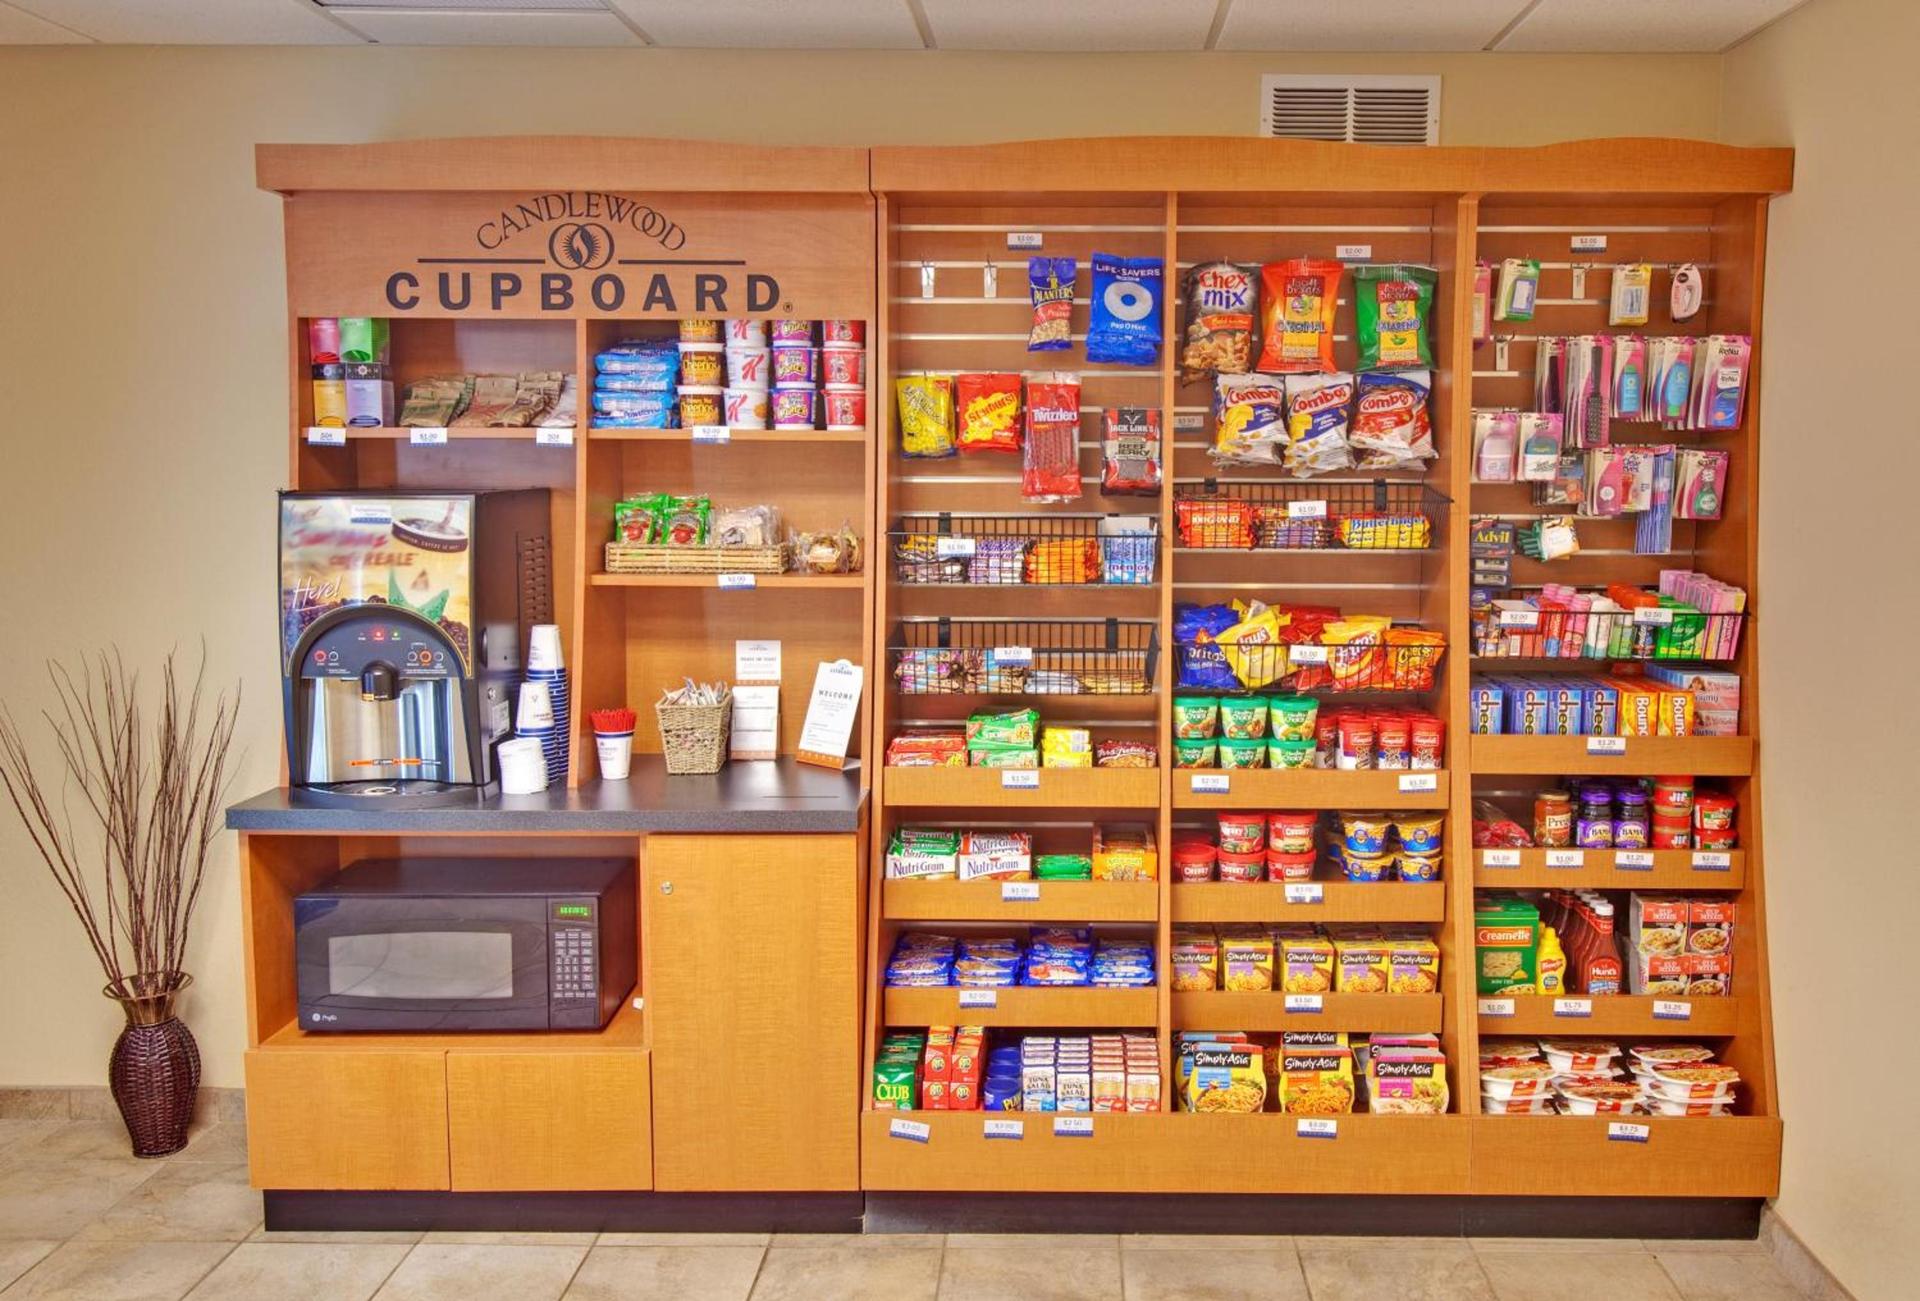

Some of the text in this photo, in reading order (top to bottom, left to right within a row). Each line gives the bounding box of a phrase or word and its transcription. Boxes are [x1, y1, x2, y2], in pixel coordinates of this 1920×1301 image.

[476, 191, 687, 251] CANDLEWOOD
[1199, 270, 1250, 290] Chex
[385, 271, 782, 313] CUPBOARD
[1203, 287, 1248, 310] mix
[1474, 530, 1510, 543] Advil
[292, 575, 342, 607] Here!
[818, 689, 854, 700] WELCOME
[1591, 967, 1617, 976] Hunt's
[1195, 1052, 1249, 1066] Simply Asia
[1284, 1057, 1339, 1070] Simply Asia
[1377, 1063, 1432, 1075] Simply Asia
[876, 1082, 910, 1101] CLUB
